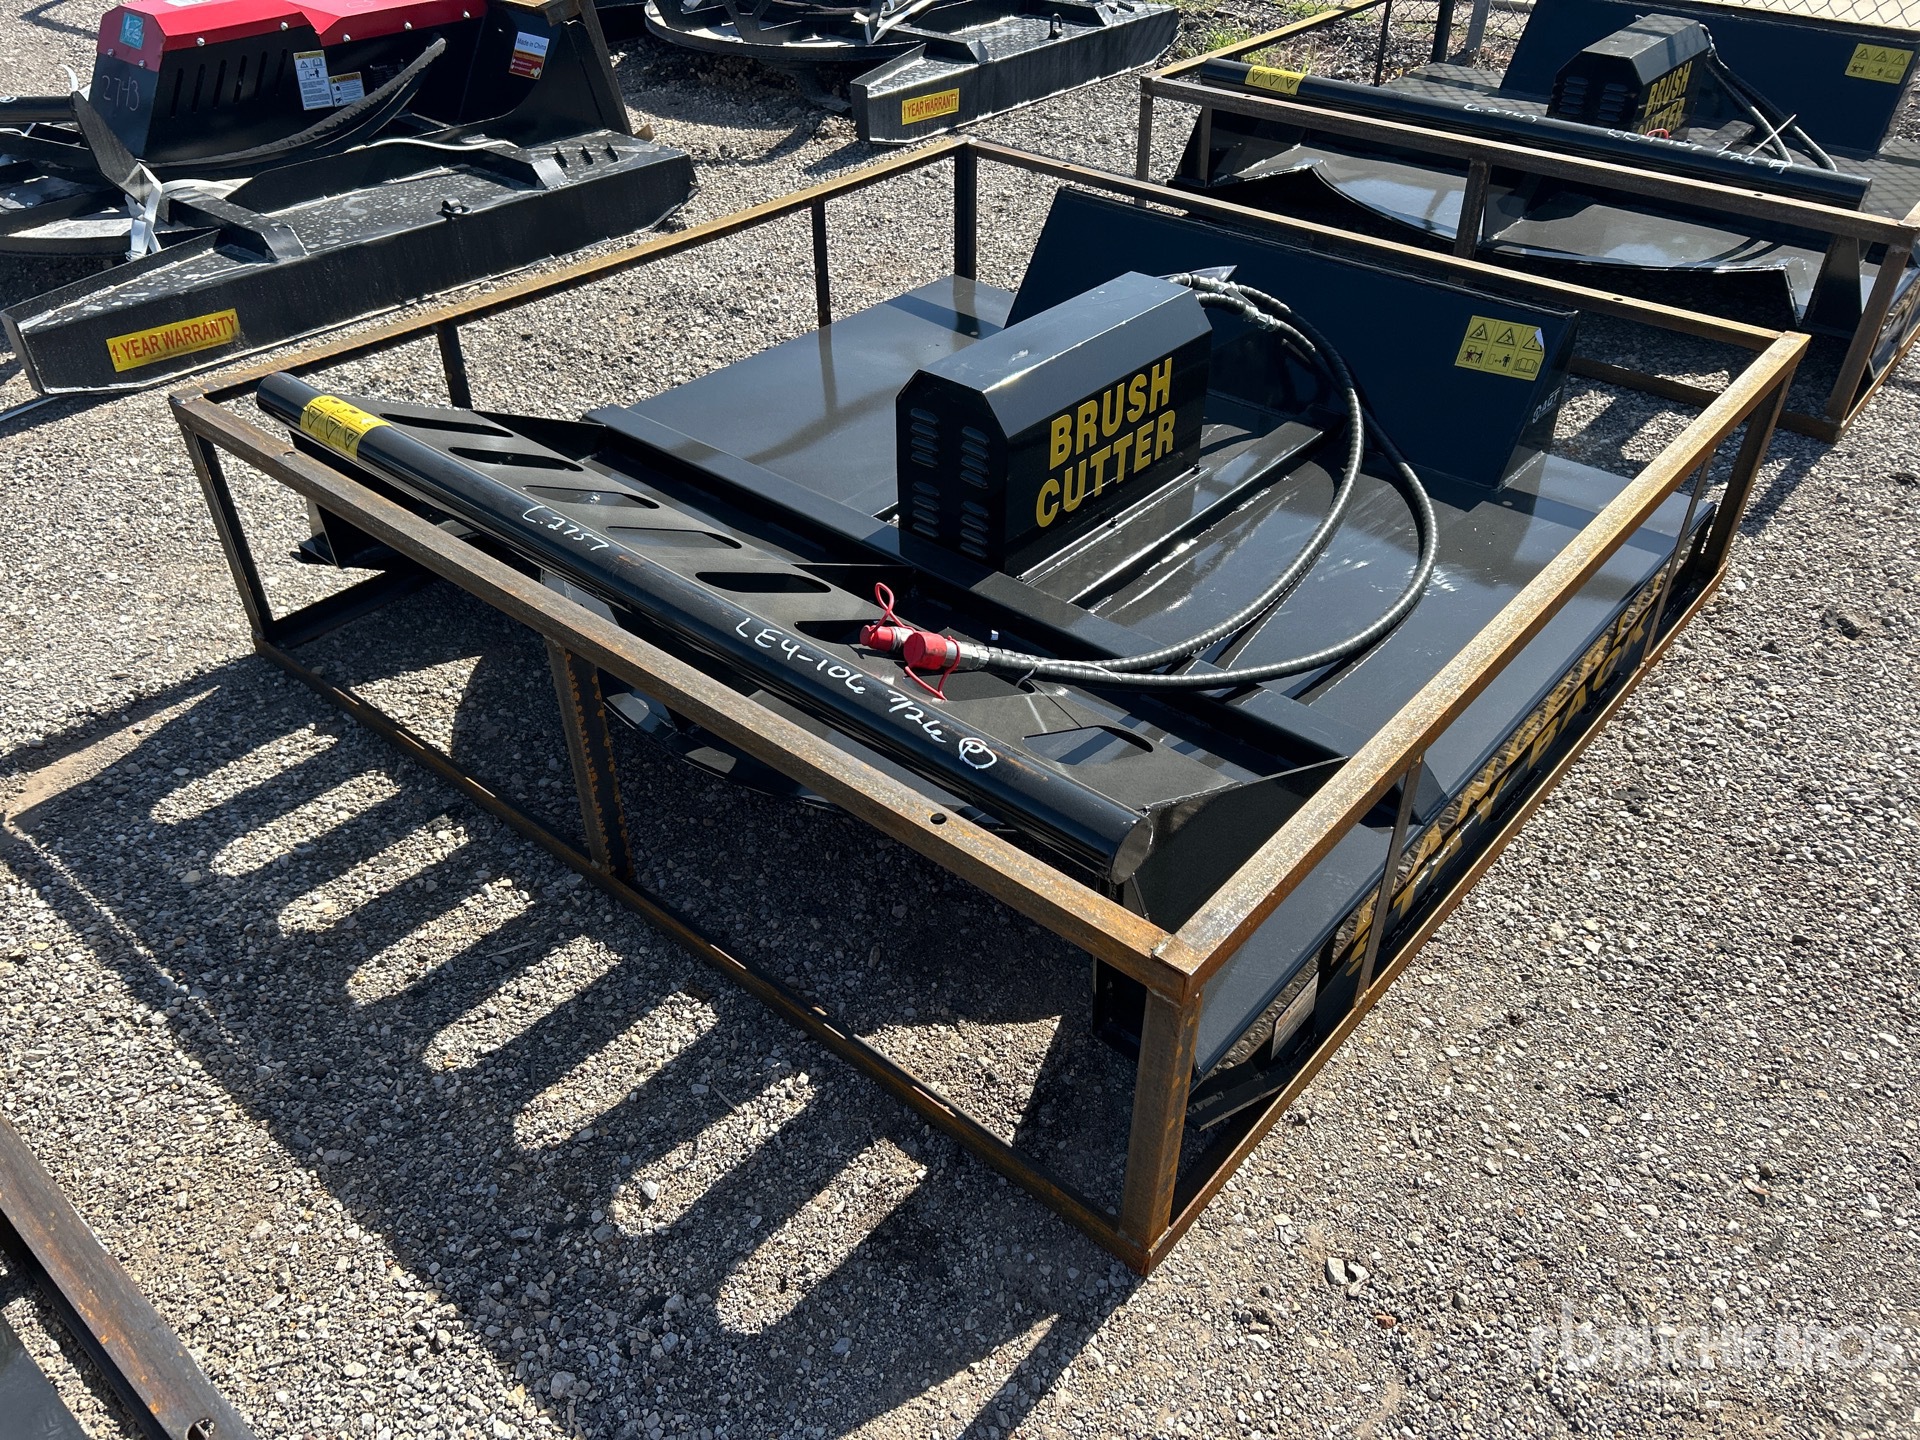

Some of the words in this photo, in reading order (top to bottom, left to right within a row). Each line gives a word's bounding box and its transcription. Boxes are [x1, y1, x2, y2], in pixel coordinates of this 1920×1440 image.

[517, 38, 529, 47] Made
[534, 42, 547, 50] China
[102, 75, 139, 111] 2743
[907, 101, 924, 118] YEAR
[924, 93, 957, 113] WARRANTY
[1644, 60, 1693, 118] BRUSH
[112, 344, 121, 363] 1
[120, 334, 162, 361] YEAR
[161, 314, 236, 350] WARRANTY
[1049, 356, 1173, 471] BRUSH
[1035, 409, 1176, 528] CUTTER
[735, 617, 866, 695] LE4-106
[1527, 604, 1653, 771] BACK
